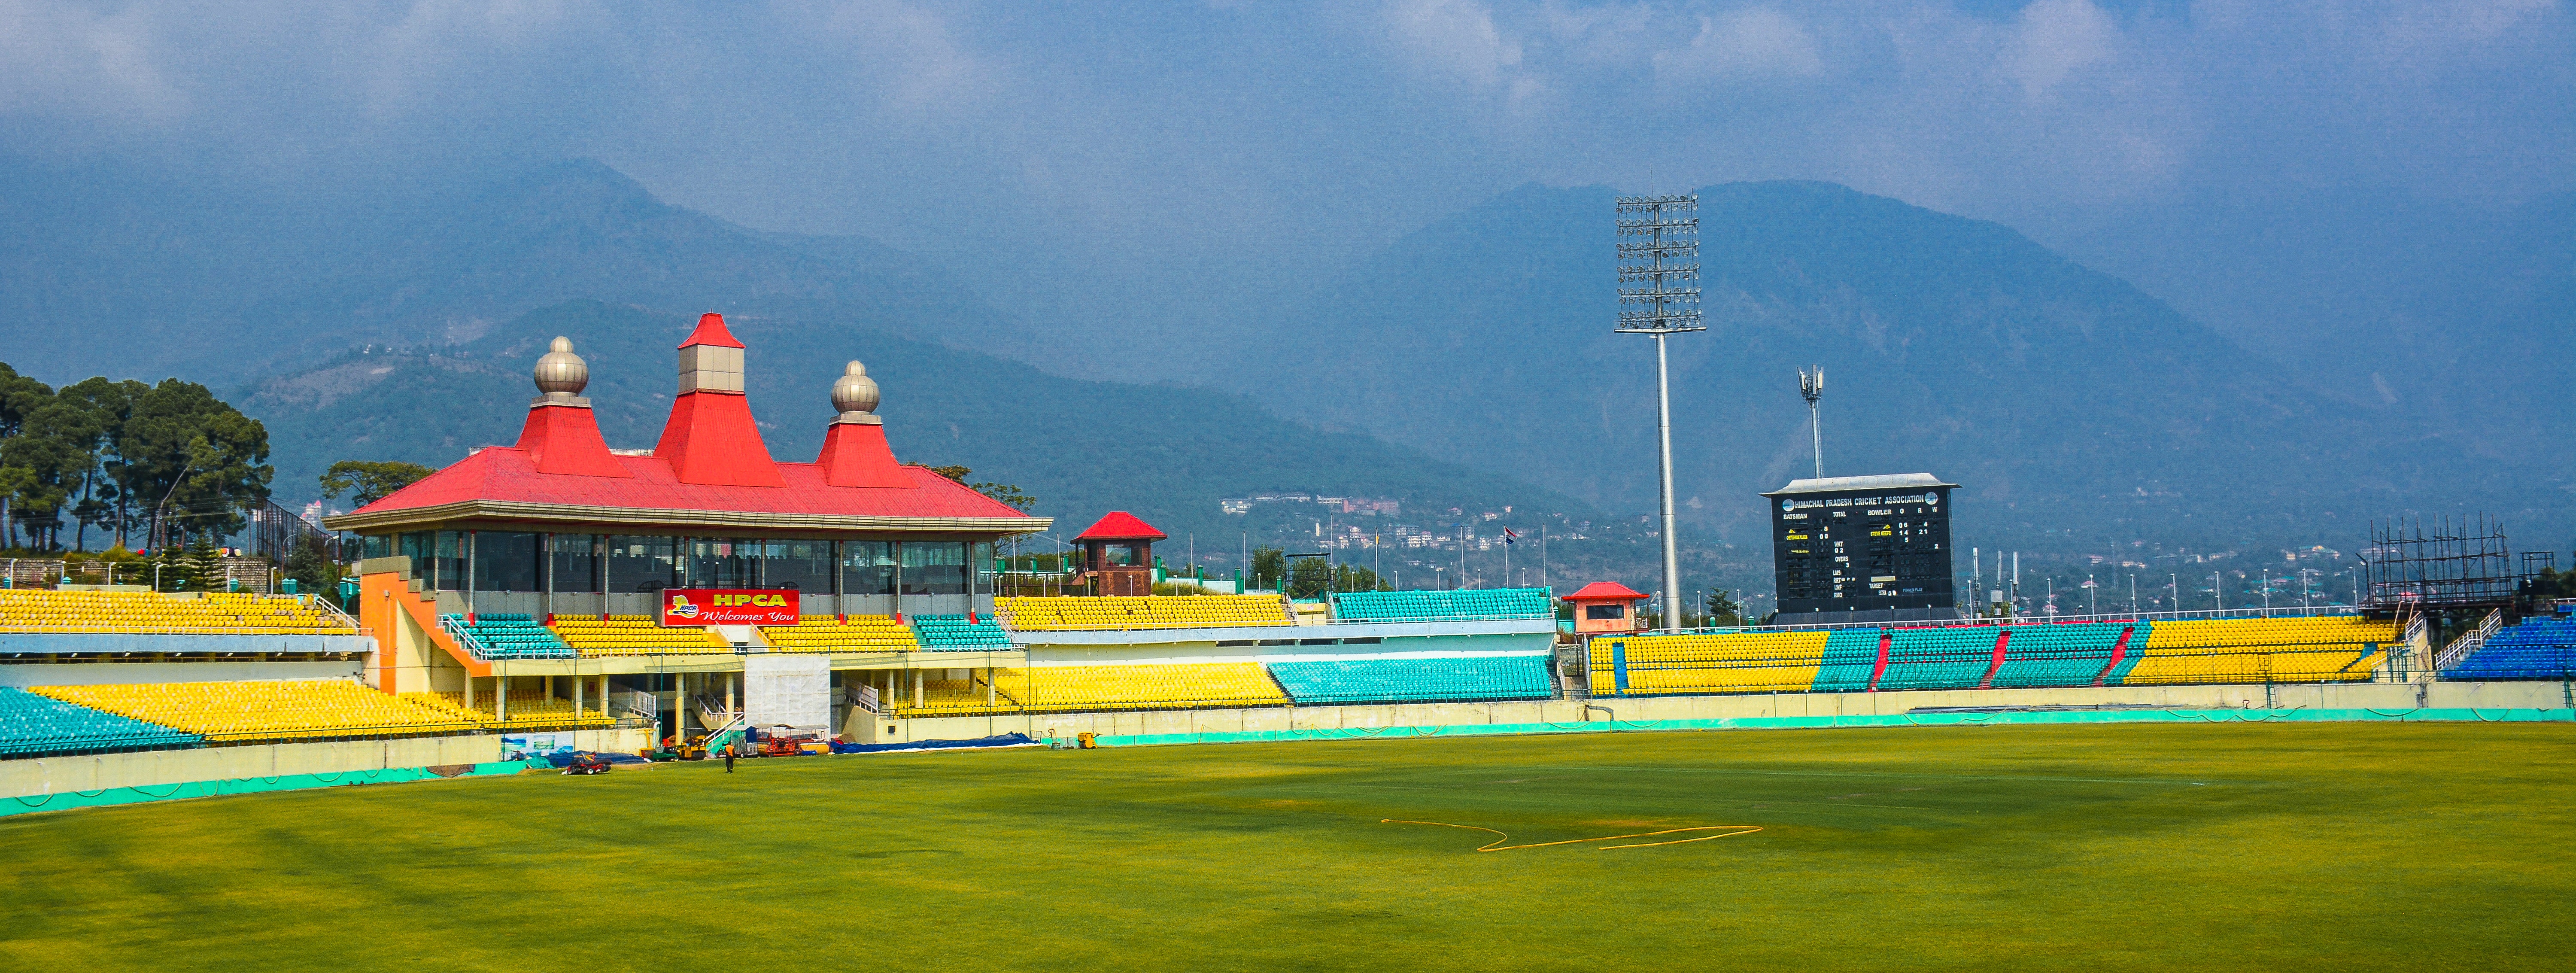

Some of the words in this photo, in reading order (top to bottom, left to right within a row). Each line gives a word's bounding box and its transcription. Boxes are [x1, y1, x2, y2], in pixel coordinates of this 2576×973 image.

[1795, 500, 1824, 508] HIMACHAL
[1826, 499, 1852, 507] PRADESH
[1855, 497, 1882, 505] CRICKET
[1885, 495, 1924, 504] ASSOCIATION
[714, 594, 787, 608] HPCA
[700, 611, 764, 621] Welcomes
[768, 612, 794, 621] You
